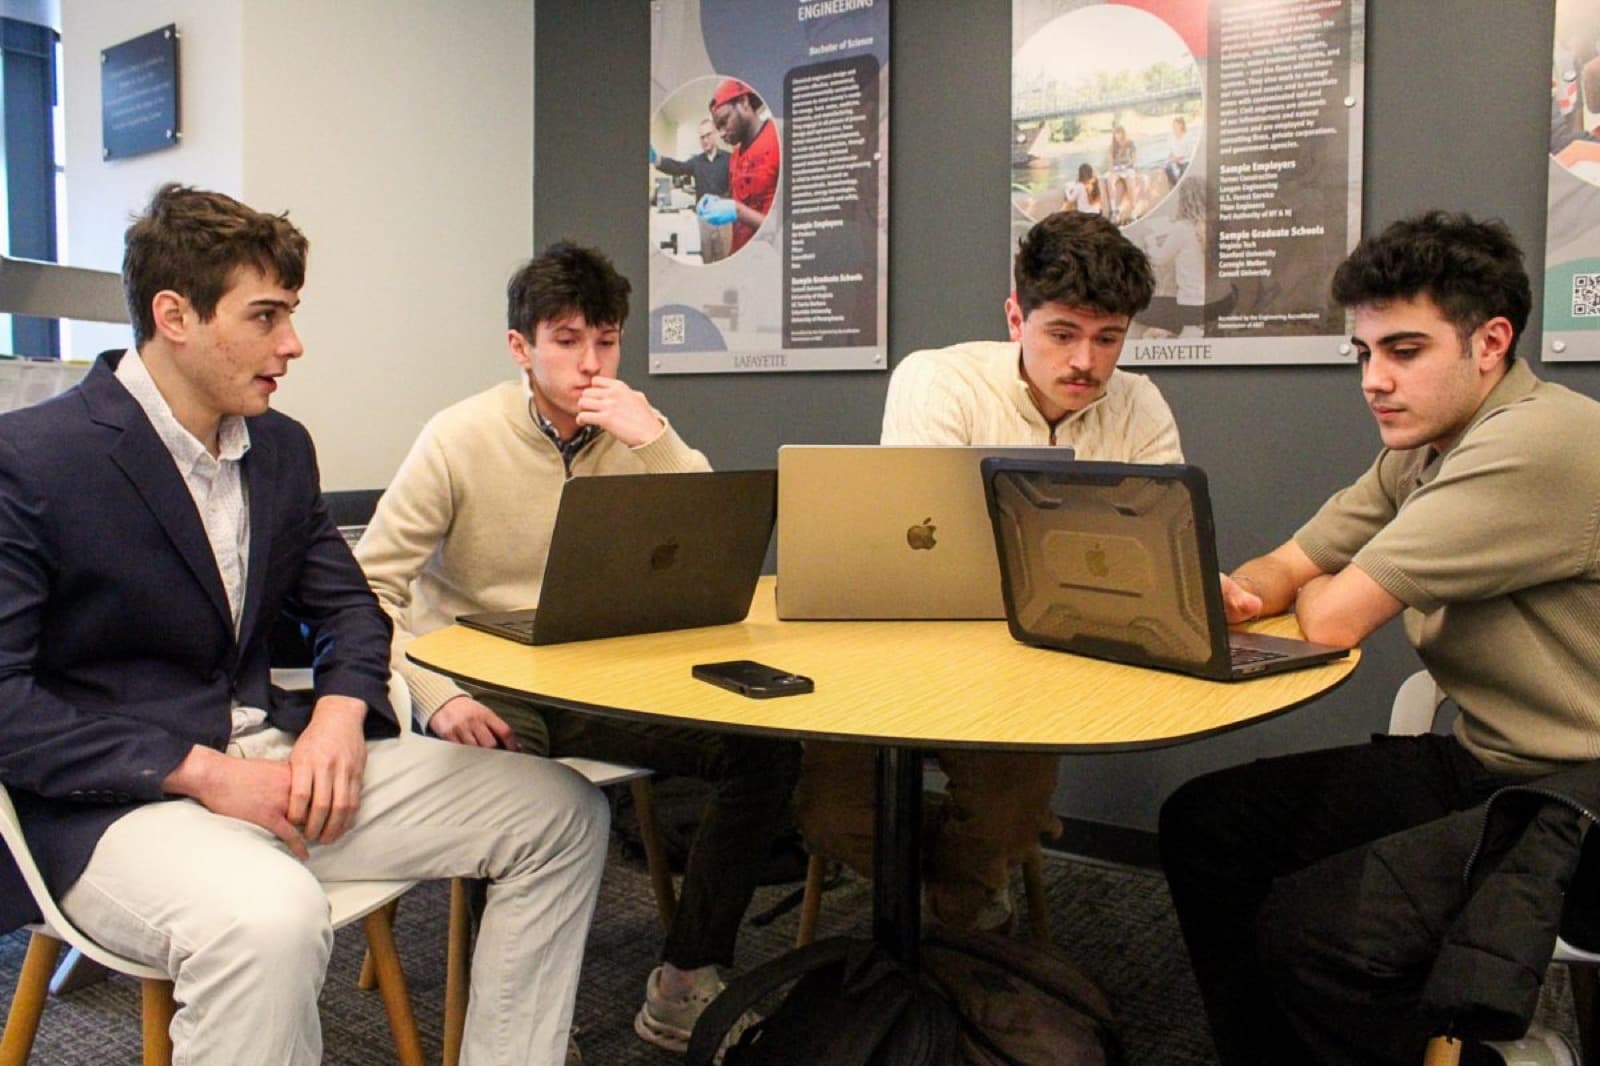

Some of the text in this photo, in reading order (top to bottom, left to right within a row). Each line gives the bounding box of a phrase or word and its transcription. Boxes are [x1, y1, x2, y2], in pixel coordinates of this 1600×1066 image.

[798, 0, 873, 20] ENGINEERING
[839, 40, 847, 50] of
[847, 37, 873, 48] Science
[1220, 160, 1296, 174] Sample Employers
[1219, 225, 1325, 241] Sample Graduate Schools
[1243, 240, 1257, 248] Tech
[1245, 249, 1277, 258] University
[840, 273, 863, 282] Schools
[1240, 269, 1272, 278] University
[1135, 344, 1212, 360] LAFAYETTE
[734, 354, 787, 368] LAFAYETTE
